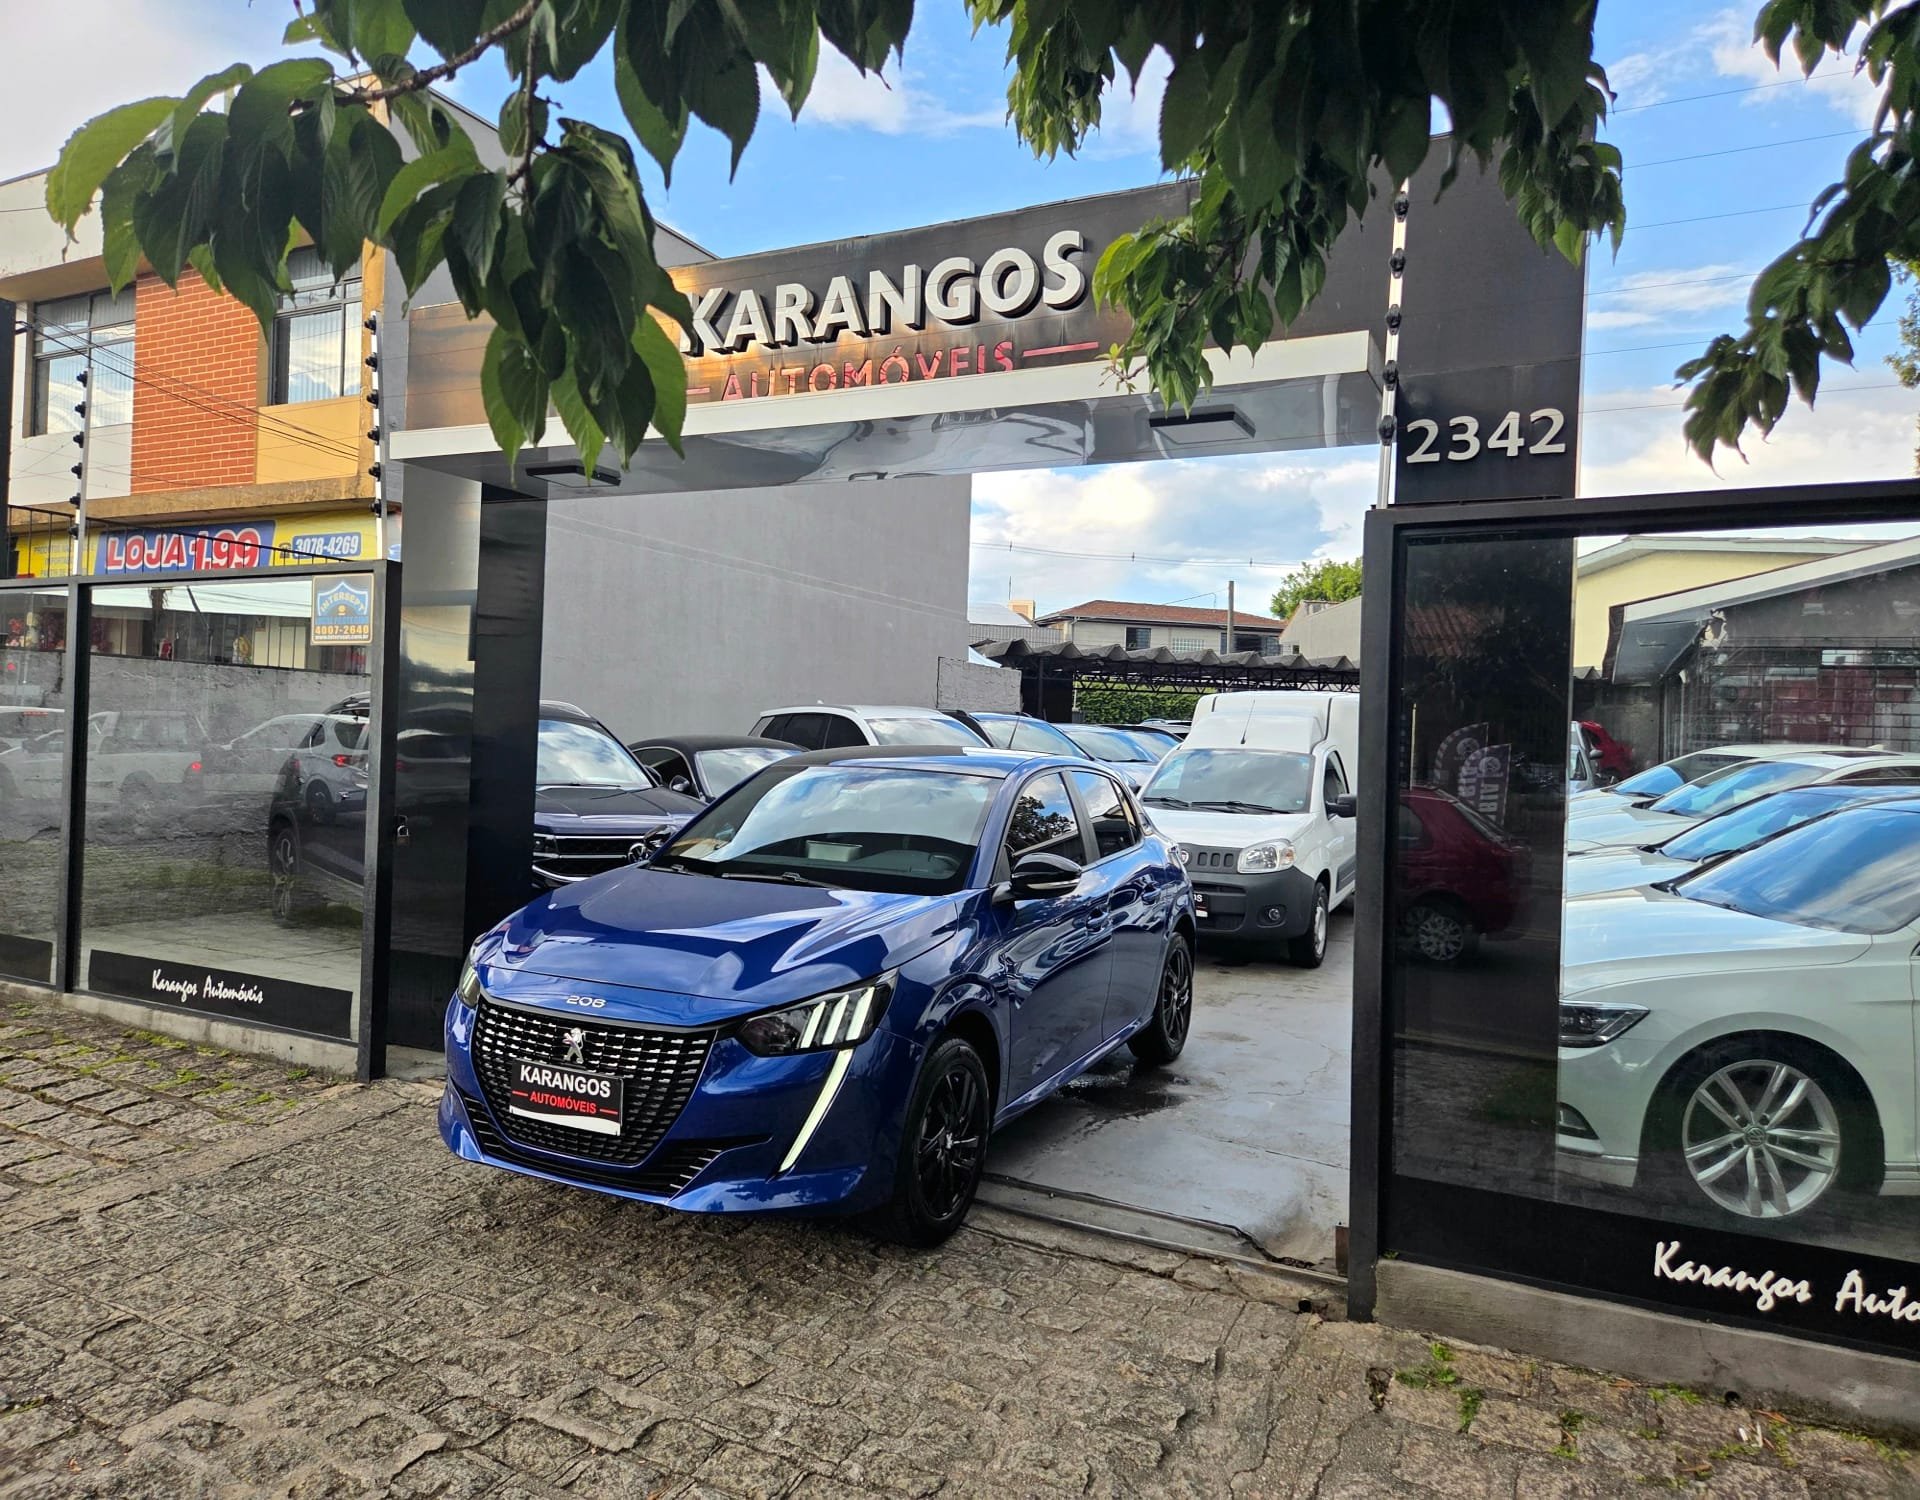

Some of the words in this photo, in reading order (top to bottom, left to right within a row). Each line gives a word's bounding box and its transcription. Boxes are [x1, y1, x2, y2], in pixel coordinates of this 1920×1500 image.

[680, 230, 1085, 354] KARANGOS
[721, 341, 1014, 400] AUTOMÓVEIS
[1406, 408, 1566, 464] 2342
[105, 534, 187, 570] LOJA
[295, 535, 359, 557] 3078-4269
[152, 969, 197, 1002] Karangos
[520, 1064, 611, 1098] KARANGOS
[529, 1091, 597, 1114] AUTOMÓVEIS
[1653, 1240, 1812, 1312] Karangos
